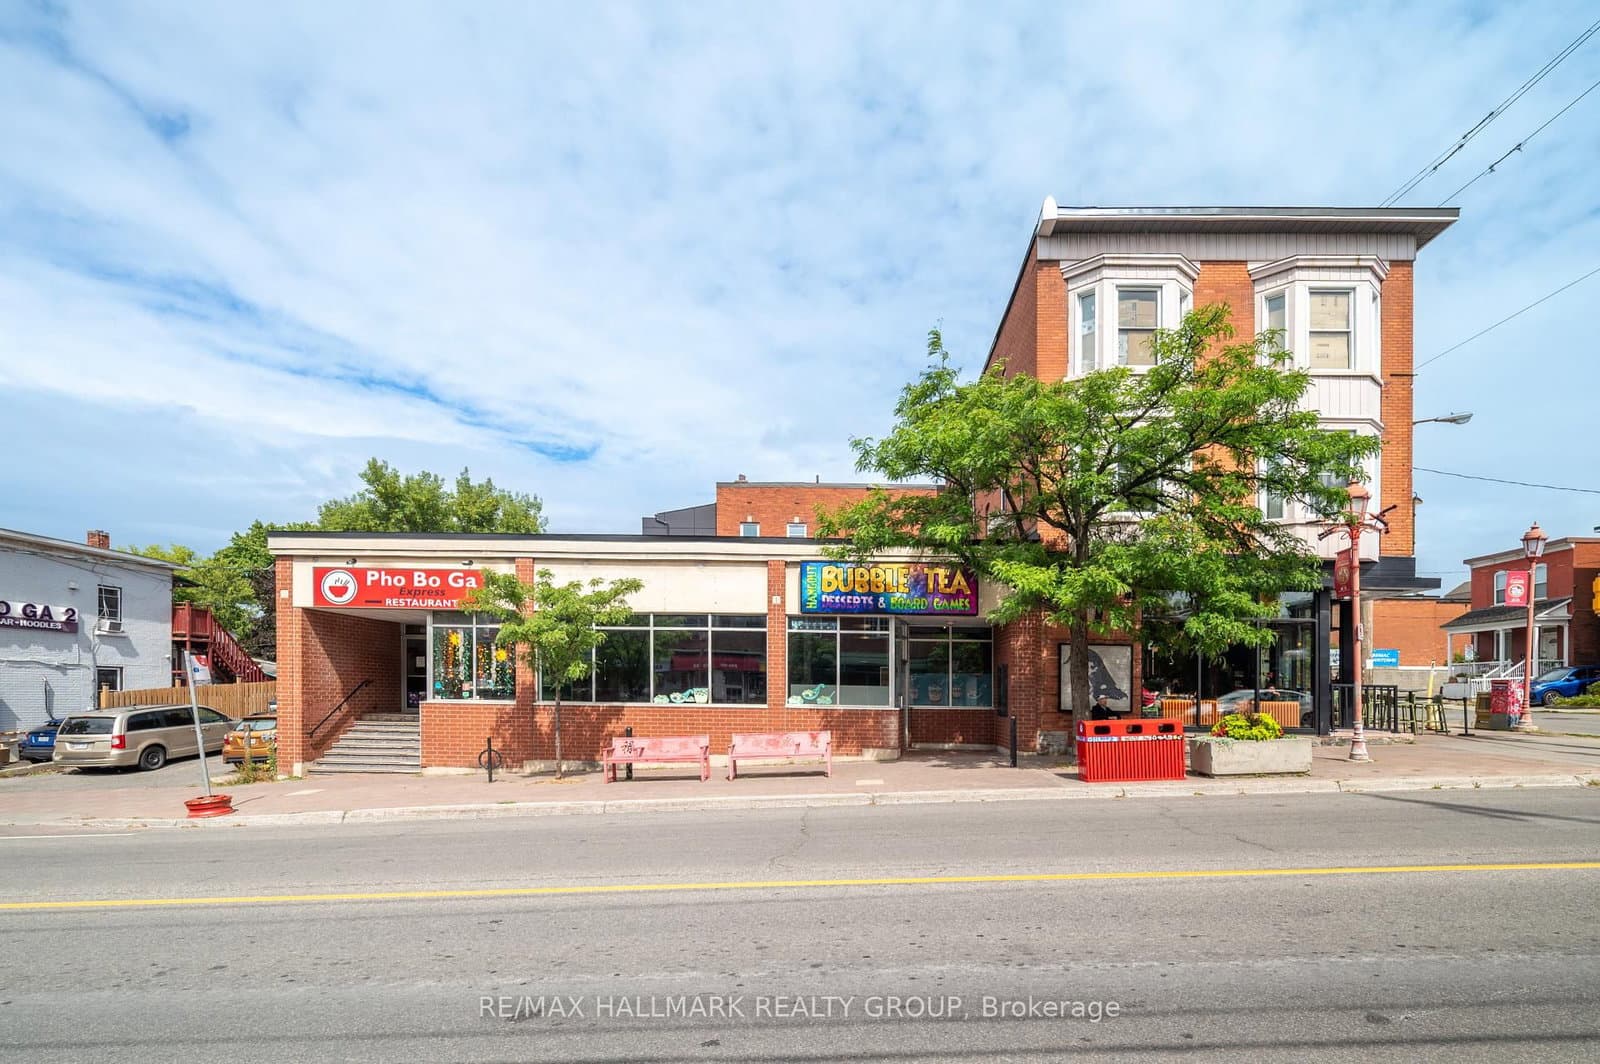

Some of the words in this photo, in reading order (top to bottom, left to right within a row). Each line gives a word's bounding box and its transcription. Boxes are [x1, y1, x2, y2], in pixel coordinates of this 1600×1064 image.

[366, 571, 406, 587] Pho
[413, 571, 441, 588] Bo
[447, 571, 478, 588] Ga
[806, 565, 818, 609] HANGOUT
[821, 565, 910, 594] BUBBLE
[924, 566, 971, 595] TEA
[400, 587, 446, 598] Express
[385, 598, 457, 608] RESTAURANT
[821, 595, 874, 609] DESSERTS
[878, 596, 887, 609] &
[890, 596, 928, 610] BOARD
[933, 597, 970, 611] GAMES
[22, 603, 53, 620] GA
[64, 607, 77, 622] 2
